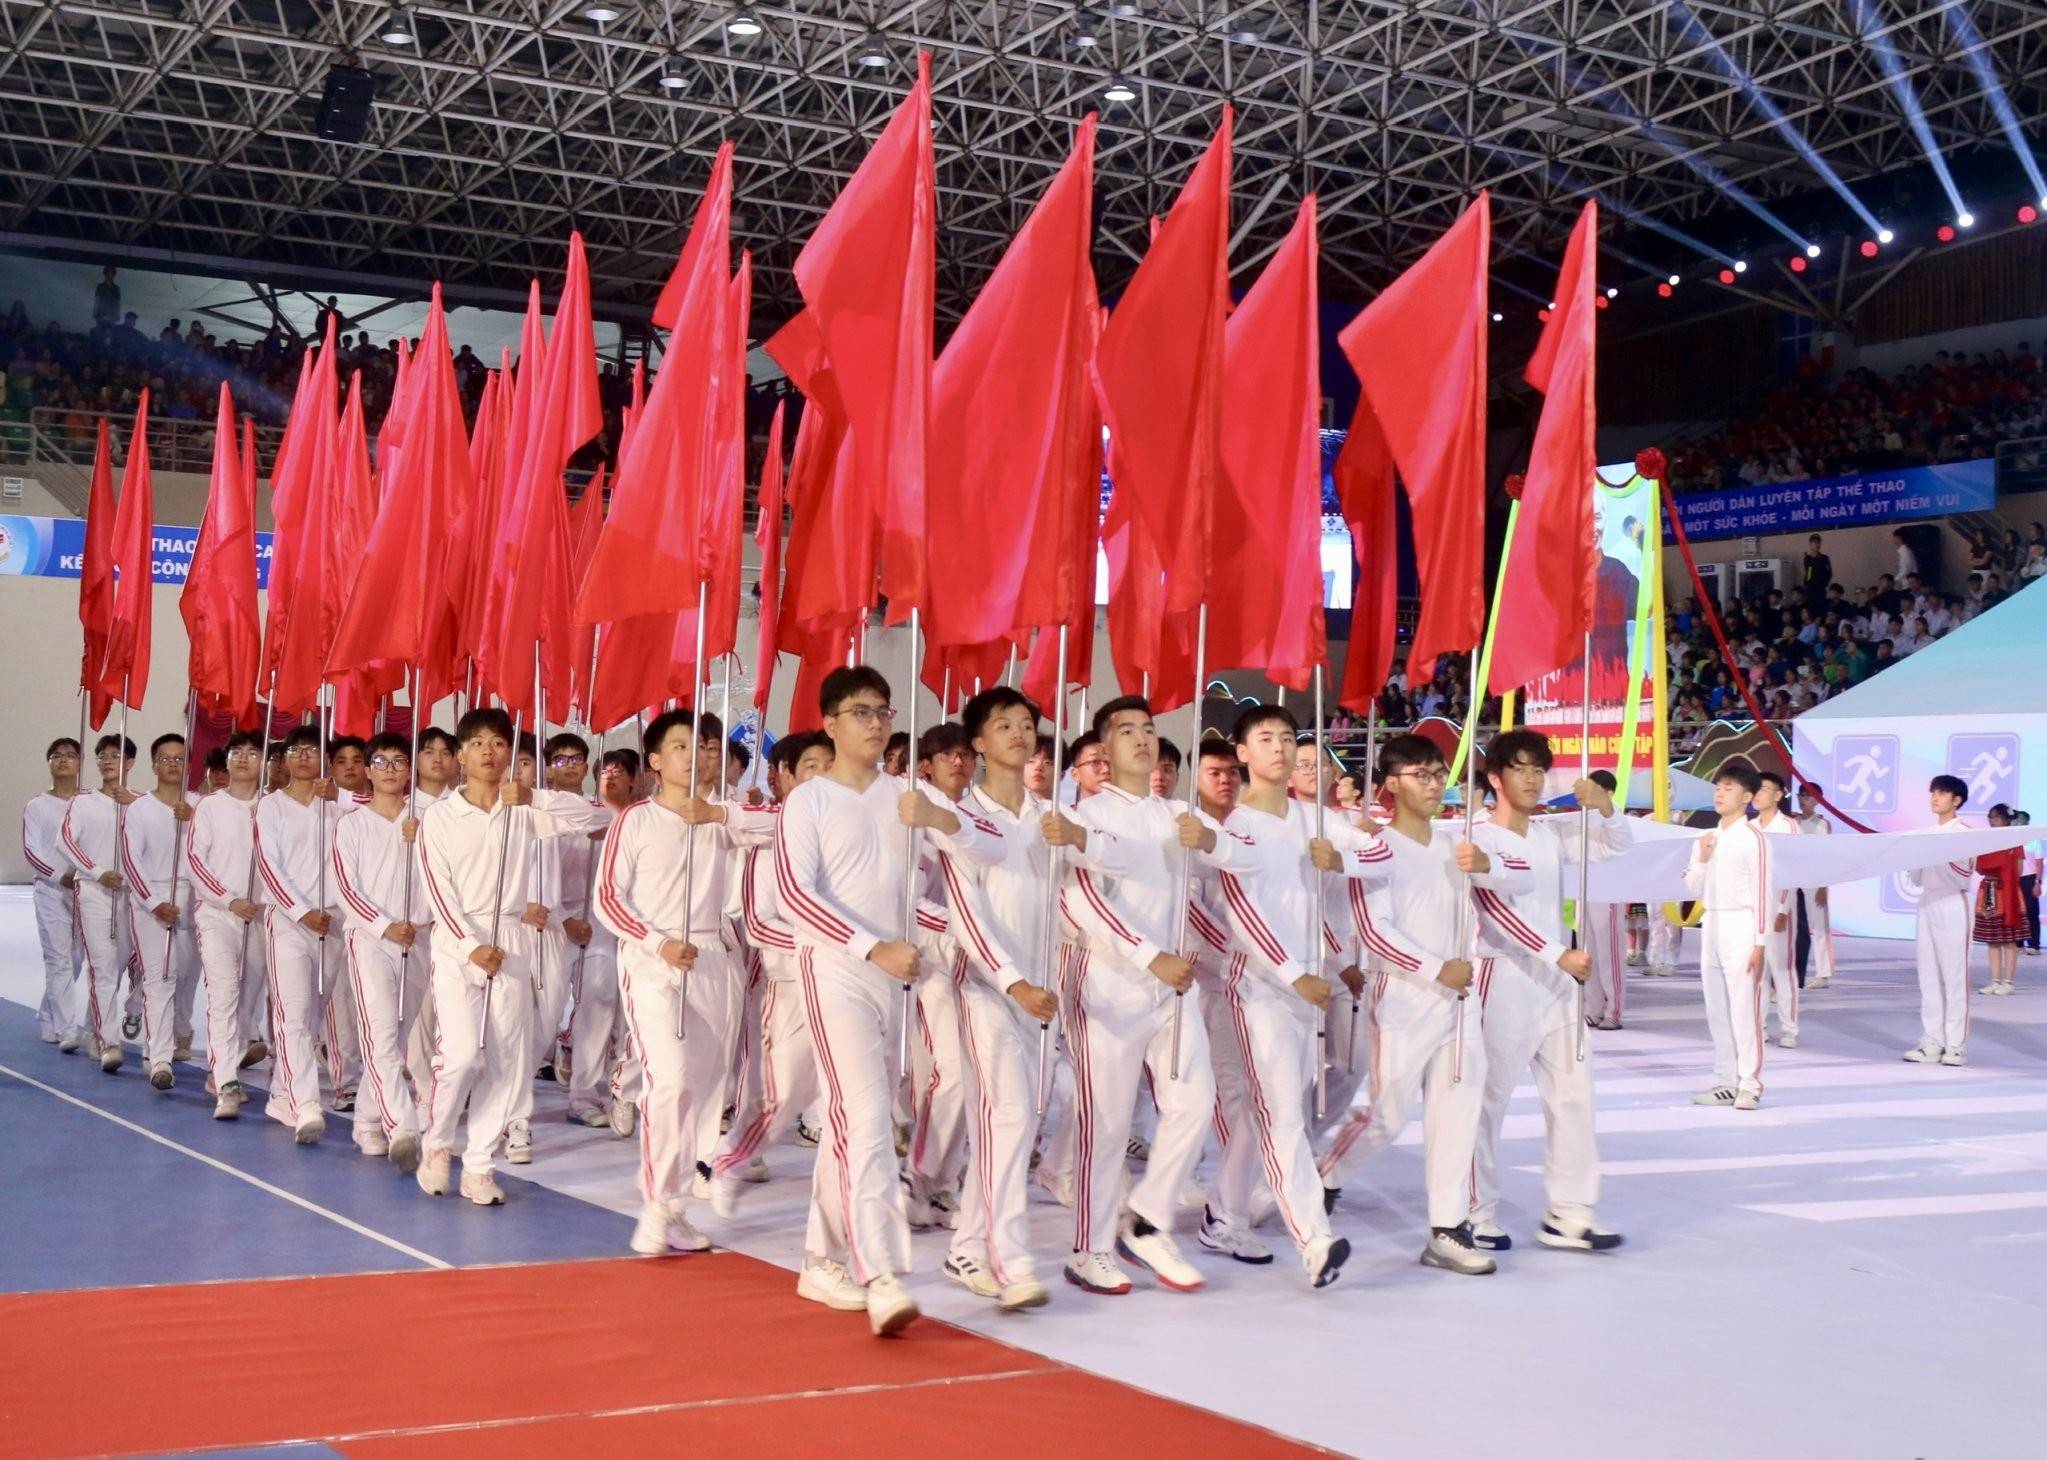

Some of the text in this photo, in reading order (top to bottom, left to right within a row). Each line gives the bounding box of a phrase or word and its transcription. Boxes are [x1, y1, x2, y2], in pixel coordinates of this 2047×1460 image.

[1688, 497, 1725, 515] NGƯỜI
[1729, 495, 1756, 510] DÂN
[1760, 488, 1802, 506] LUYỆN
[1806, 486, 1832, 503] TẬP
[1836, 478, 1863, 497] THỂ
[1868, 479, 1906, 494] THAO
[1714, 515, 1738, 530] SỨC
[1742, 510, 1777, 527] KHỎE
[1819, 503, 1857, 519] NGÀY
[1861, 498, 1890, 517] MỘT
[1895, 493, 1931, 512] NIỀM
[1935, 494, 1960, 507] VUI
[152, 559, 189, 579] CỘN
[1635, 732, 1654, 758] TẬP
